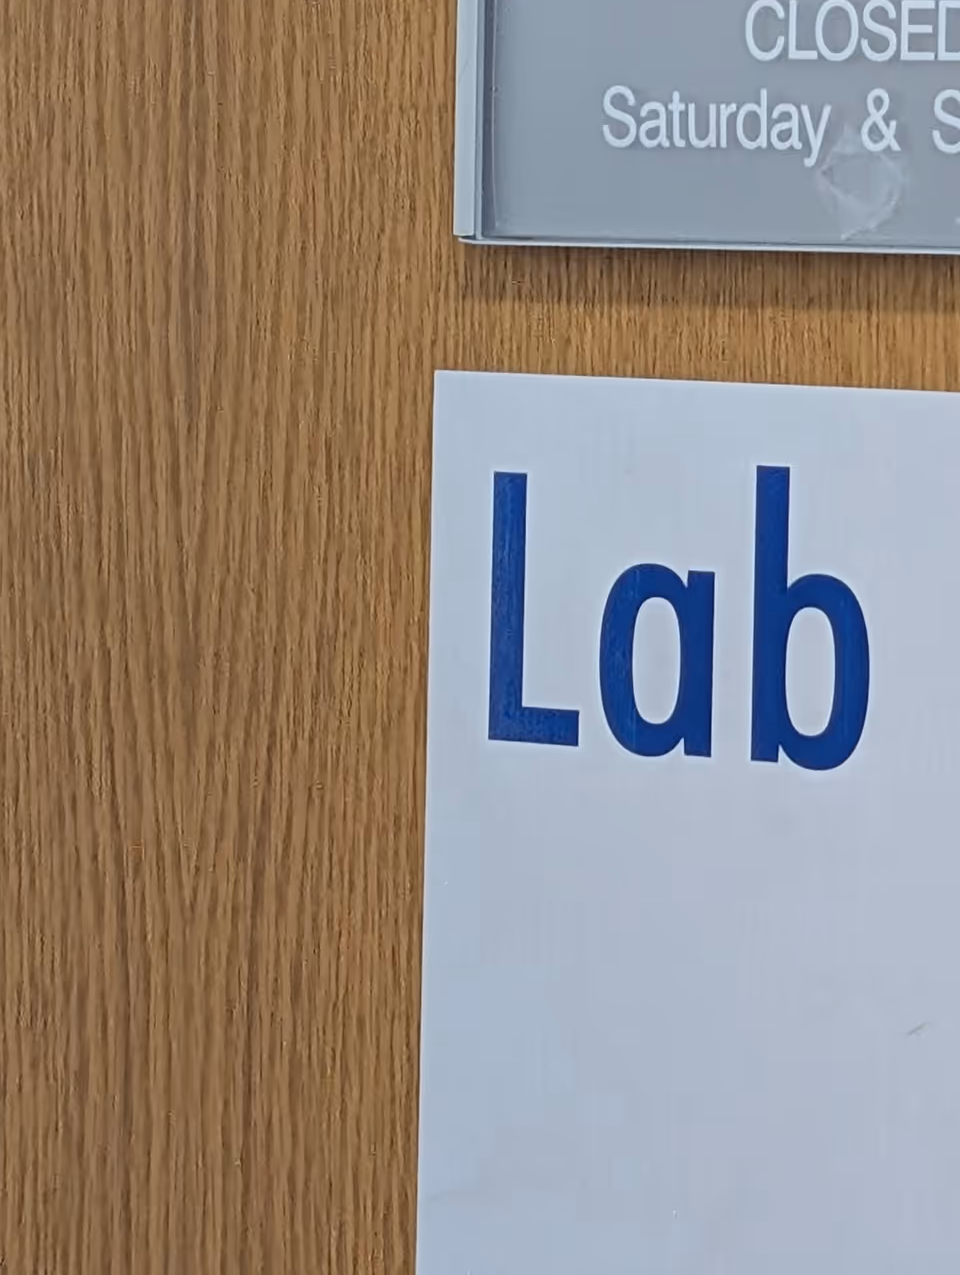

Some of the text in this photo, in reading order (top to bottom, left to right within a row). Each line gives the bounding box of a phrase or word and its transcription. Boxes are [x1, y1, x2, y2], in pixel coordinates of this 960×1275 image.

[603, 86, 831, 167] Saturday
[861, 88, 901, 151] &
[488, 465, 869, 770] Lab
